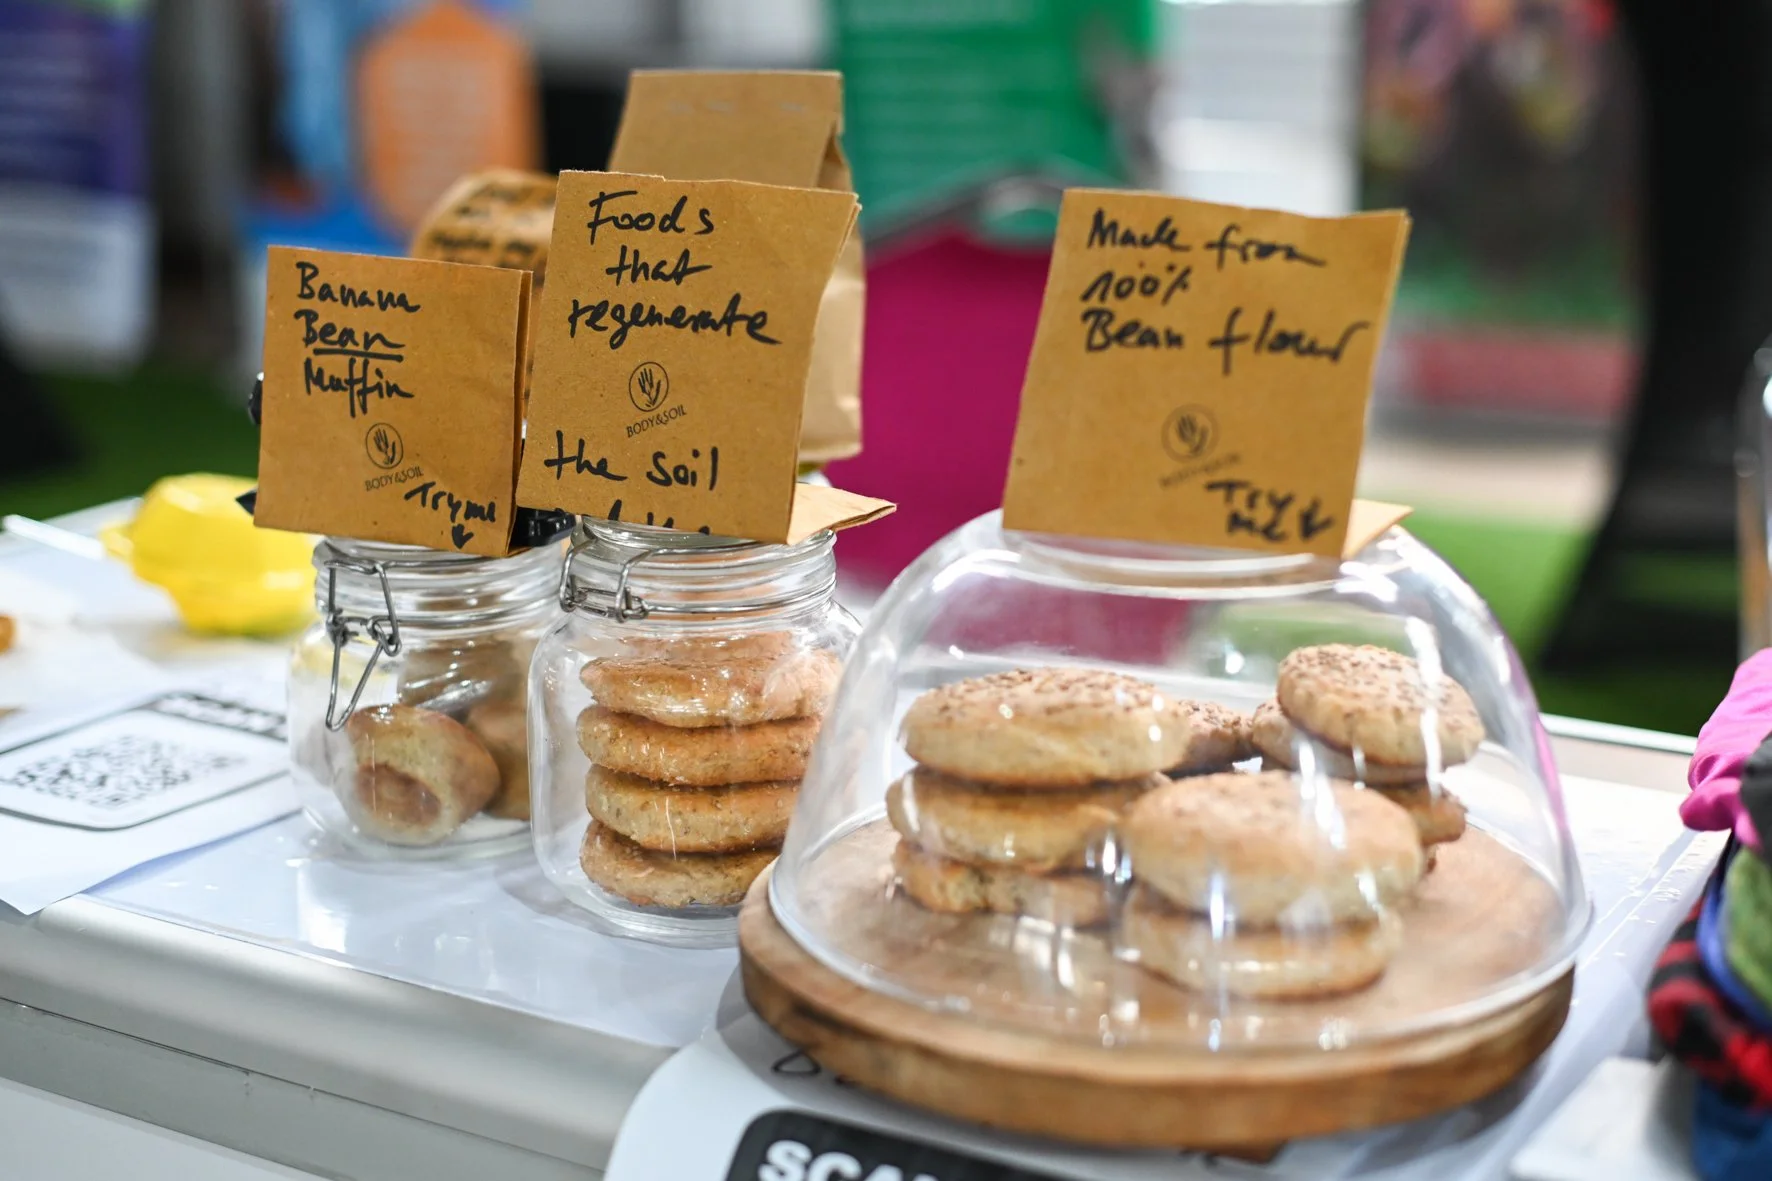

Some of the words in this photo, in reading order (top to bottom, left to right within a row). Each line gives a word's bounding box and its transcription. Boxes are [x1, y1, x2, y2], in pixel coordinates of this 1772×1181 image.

[586, 190, 714, 245] Foods
[1087, 208, 1191, 251] Made
[1205, 224, 1326, 269] from
[296, 262, 421, 312] Banana
[606, 245, 713, 286] that
[1080, 264, 1192, 306] 100%
[294, 309, 405, 349] Bean
[568, 293, 782, 349] regenerate
[1081, 308, 1184, 352] Bean
[1208, 307, 1370, 376] flour
[304, 357, 414, 418] Muffin
[626, 404, 687, 438] BODY&SOIL
[544, 430, 628, 480] the
